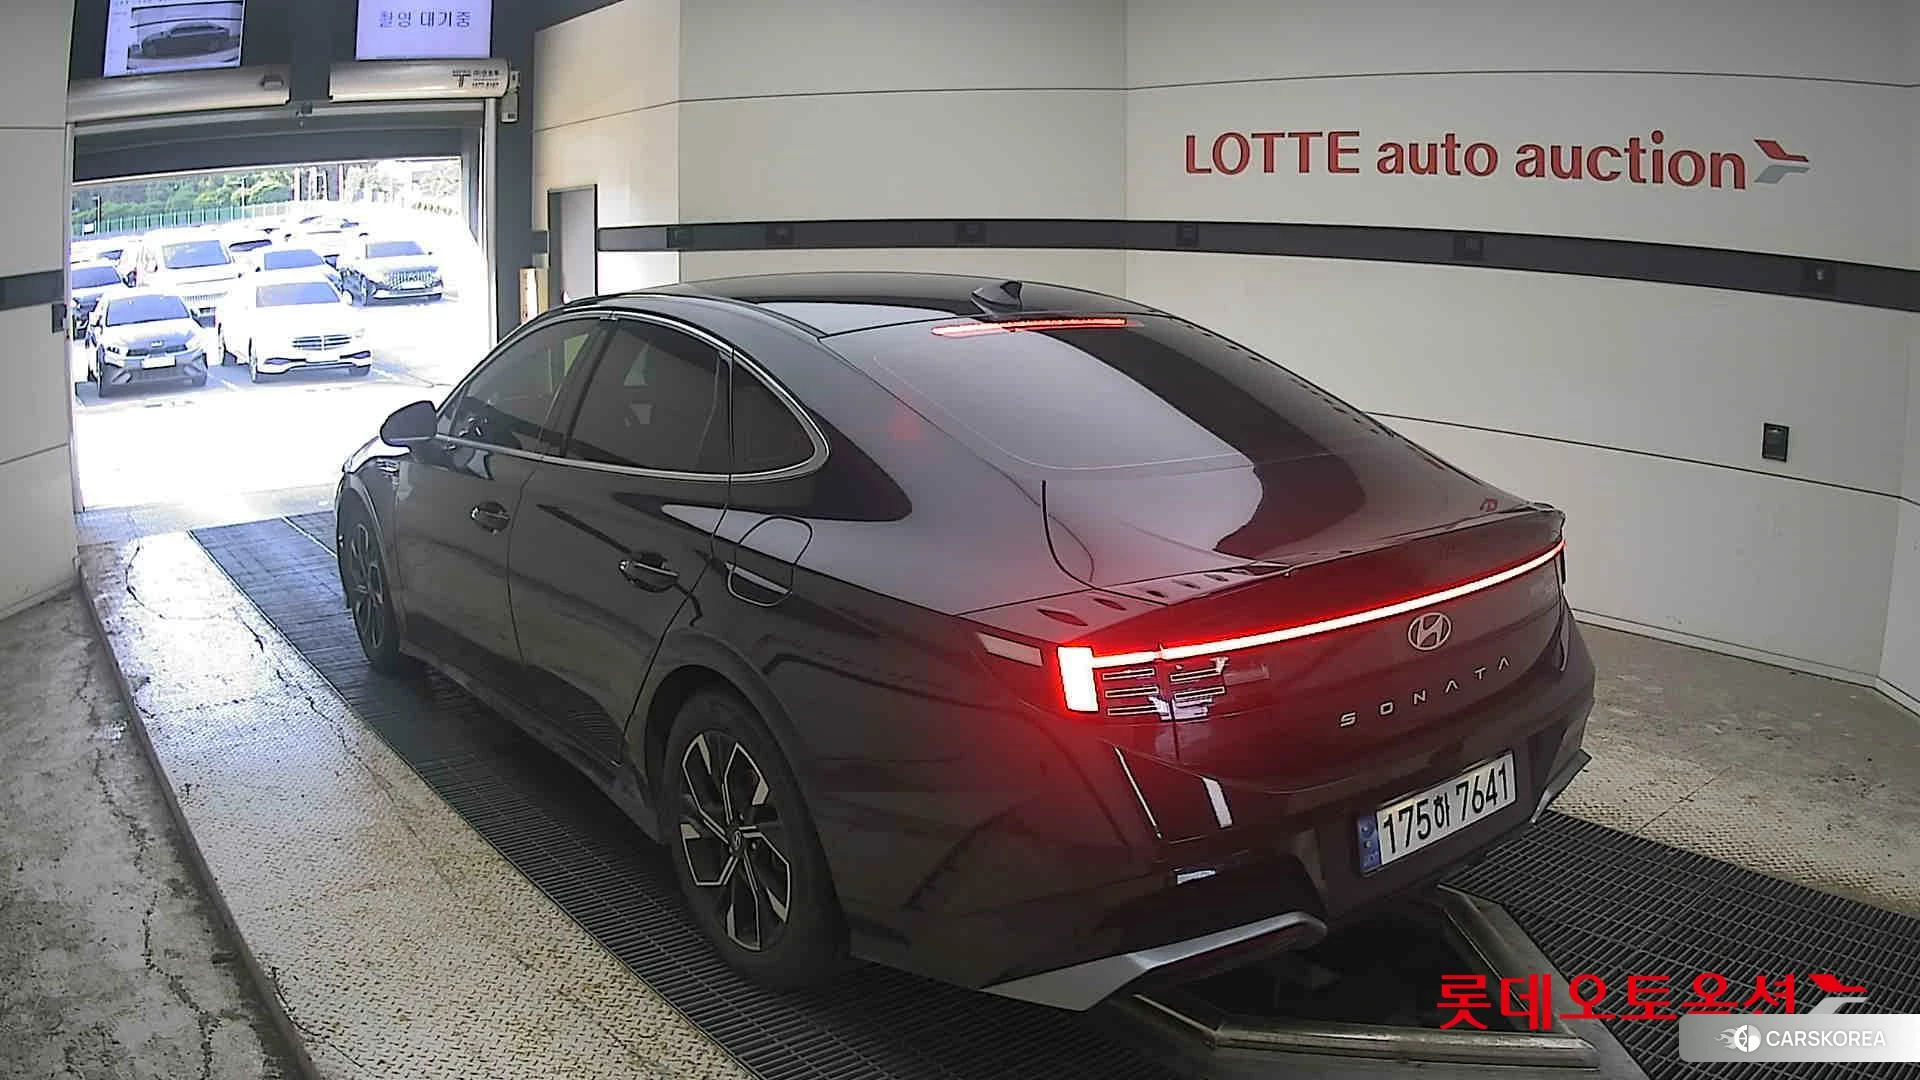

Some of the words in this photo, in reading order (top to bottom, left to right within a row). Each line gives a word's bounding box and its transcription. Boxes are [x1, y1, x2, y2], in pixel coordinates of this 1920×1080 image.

[420, 11, 471, 28] 대기중
[1185, 131, 1361, 175] LOTTE
[1376, 133, 1499, 177] auto
[1515, 130, 1747, 190] auction
[1340, 656, 1510, 727] SONATA
[1383, 794, 1450, 854] 175하
[1455, 766, 1508, 821] 7641
